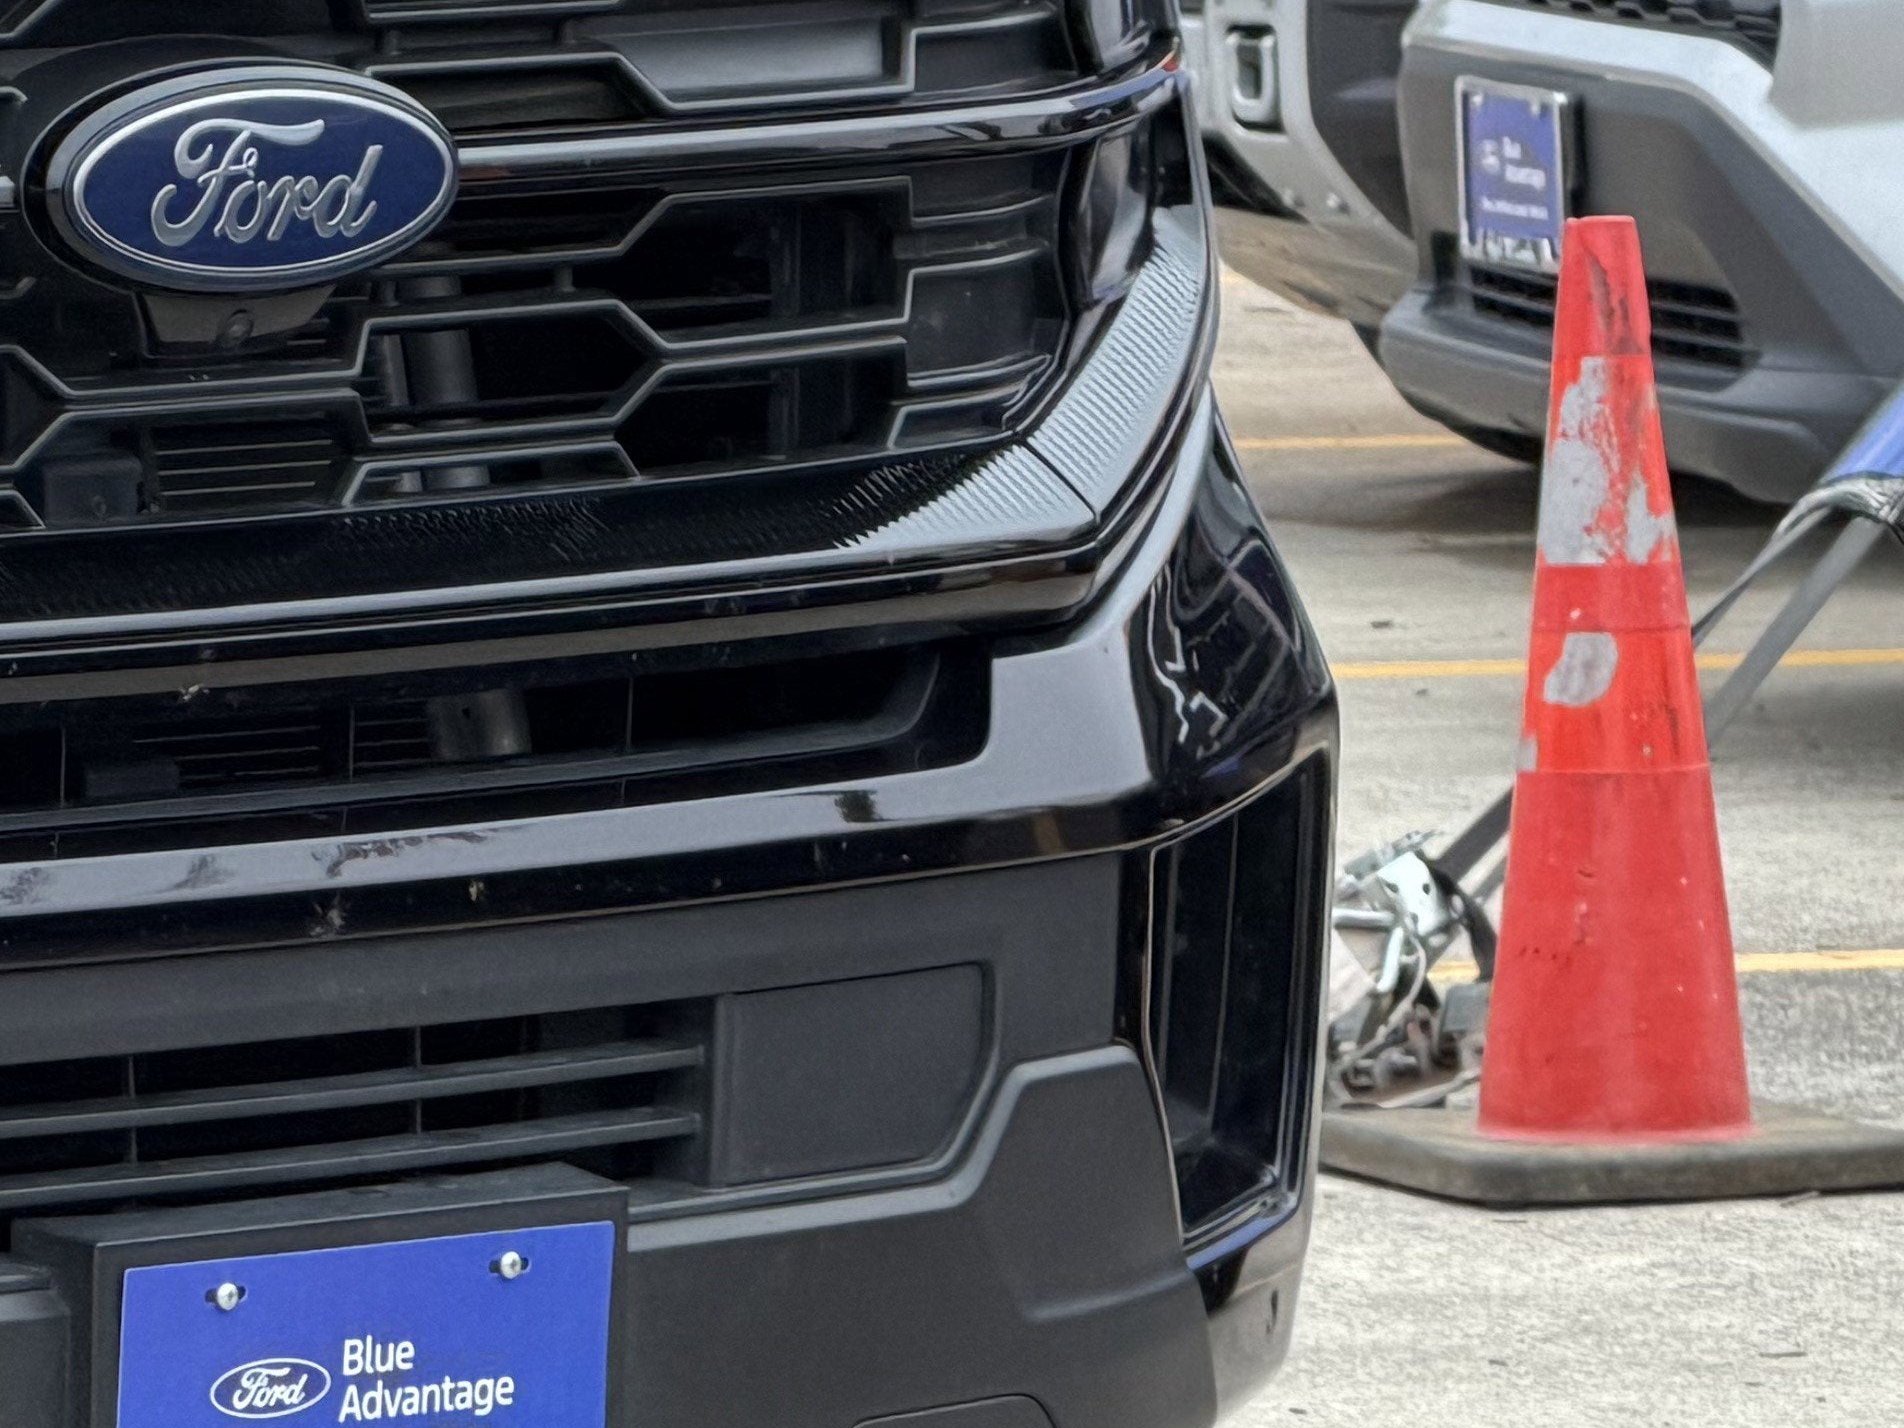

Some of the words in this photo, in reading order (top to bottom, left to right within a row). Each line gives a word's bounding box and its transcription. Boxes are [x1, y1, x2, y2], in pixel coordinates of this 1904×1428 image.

[150, 117, 384, 247] Ford
[342, 1335, 416, 1374] Blue
[232, 1365, 306, 1410] Ford
[338, 1374, 515, 1423] Advantage
